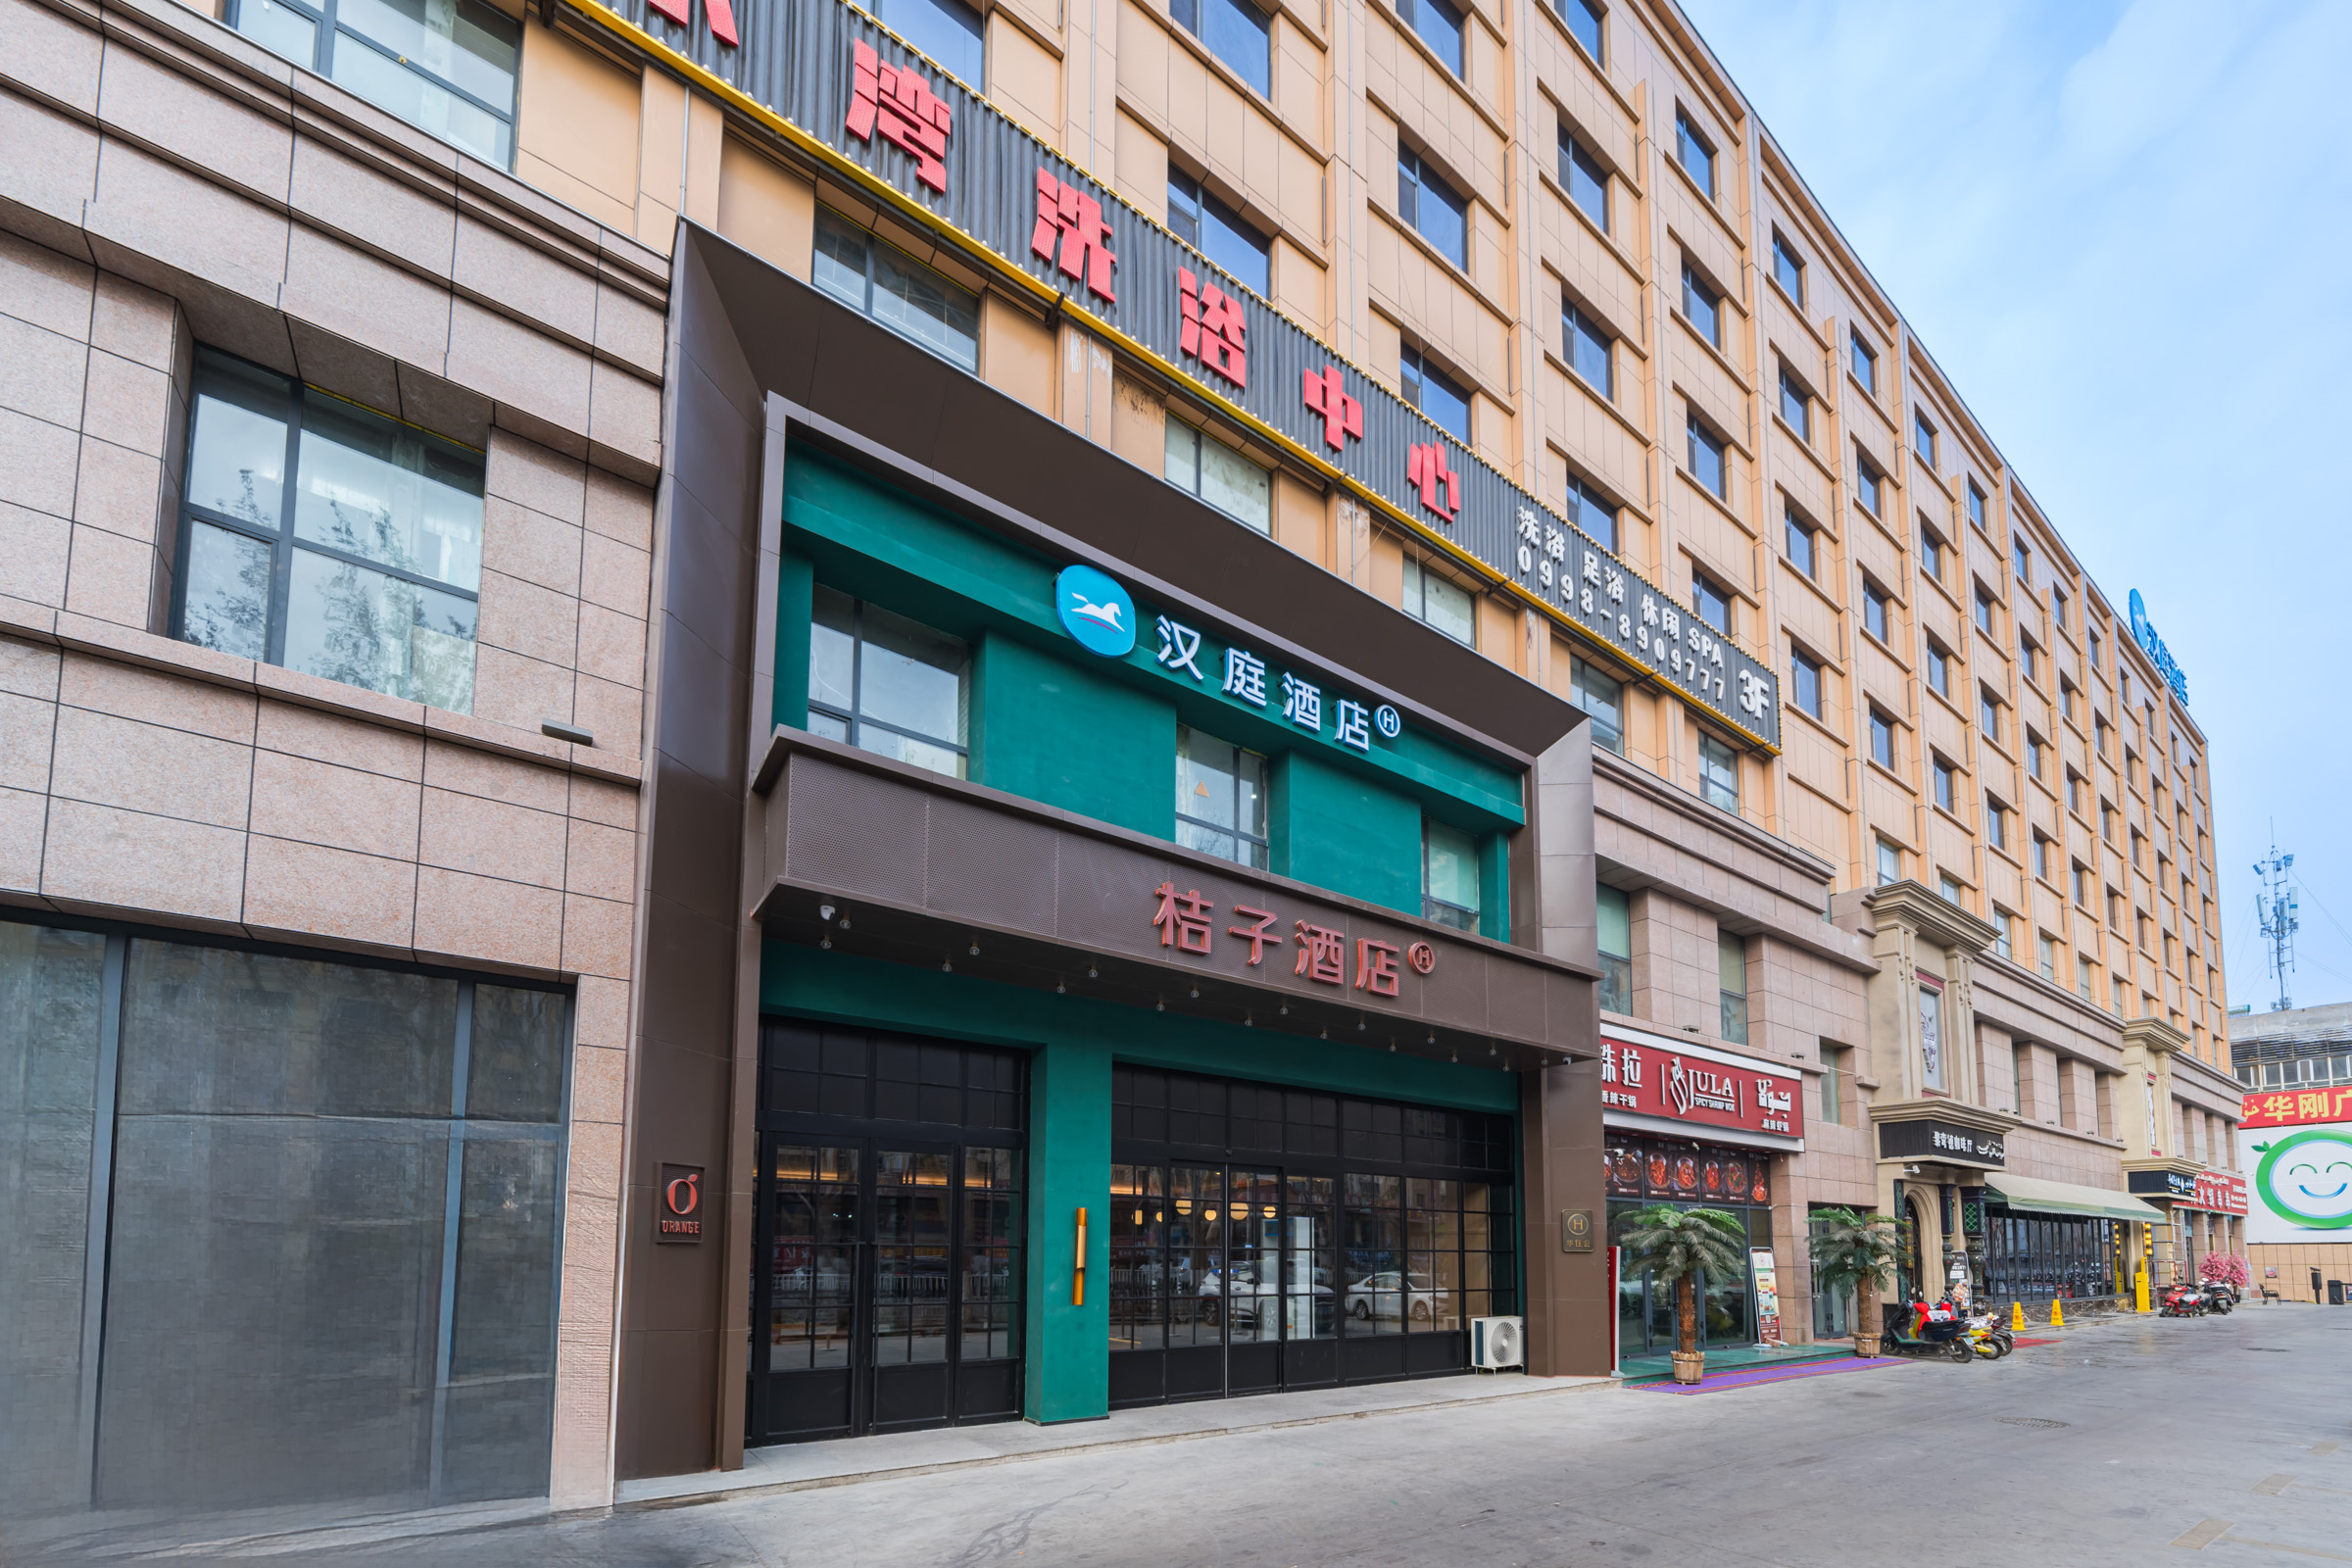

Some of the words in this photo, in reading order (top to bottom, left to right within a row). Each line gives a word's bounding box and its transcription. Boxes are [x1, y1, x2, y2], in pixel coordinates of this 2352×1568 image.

[1518, 506, 1565, 564] 洗浴
[1583, 550, 1625, 604] 足浴
[1641, 593, 1680, 640] 休闲
[1688, 627, 1723, 669] SPA
[1518, 545, 1724, 701] 0998-8909777
[1155, 614, 1370, 752] 汉庭酒店
[1739, 668, 1770, 719] 3F
[1153, 882, 1399, 998] 桔子酒店
[1687, 1068, 1735, 1109] JULA
[662, 1220, 700, 1234] ORANGE
